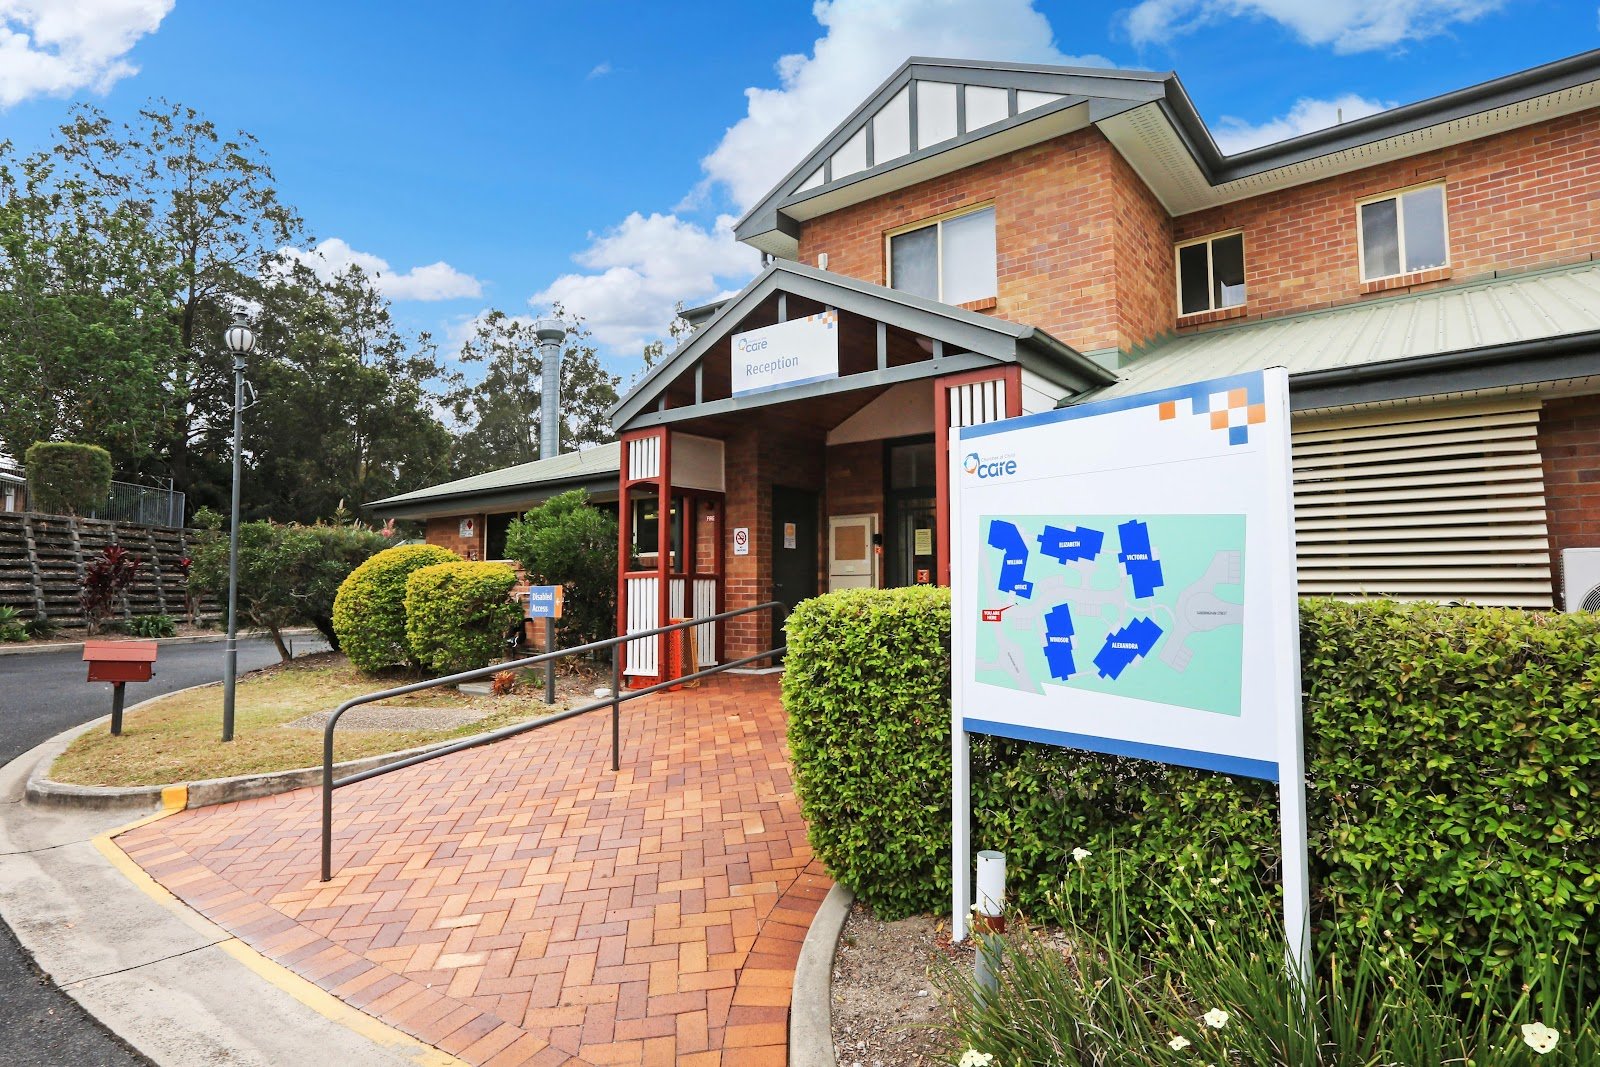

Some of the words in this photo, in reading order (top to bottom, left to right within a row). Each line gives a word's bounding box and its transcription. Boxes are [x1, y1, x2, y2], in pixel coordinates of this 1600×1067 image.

[745, 340, 768, 353] care
[746, 356, 799, 376] Reception
[977, 460, 1017, 479] care
[1126, 553, 1149, 561] VICTORIA
[532, 592, 553, 601] Disabled
[532, 604, 549, 613] Access
[1111, 642, 1139, 650] ALEXANDRA
